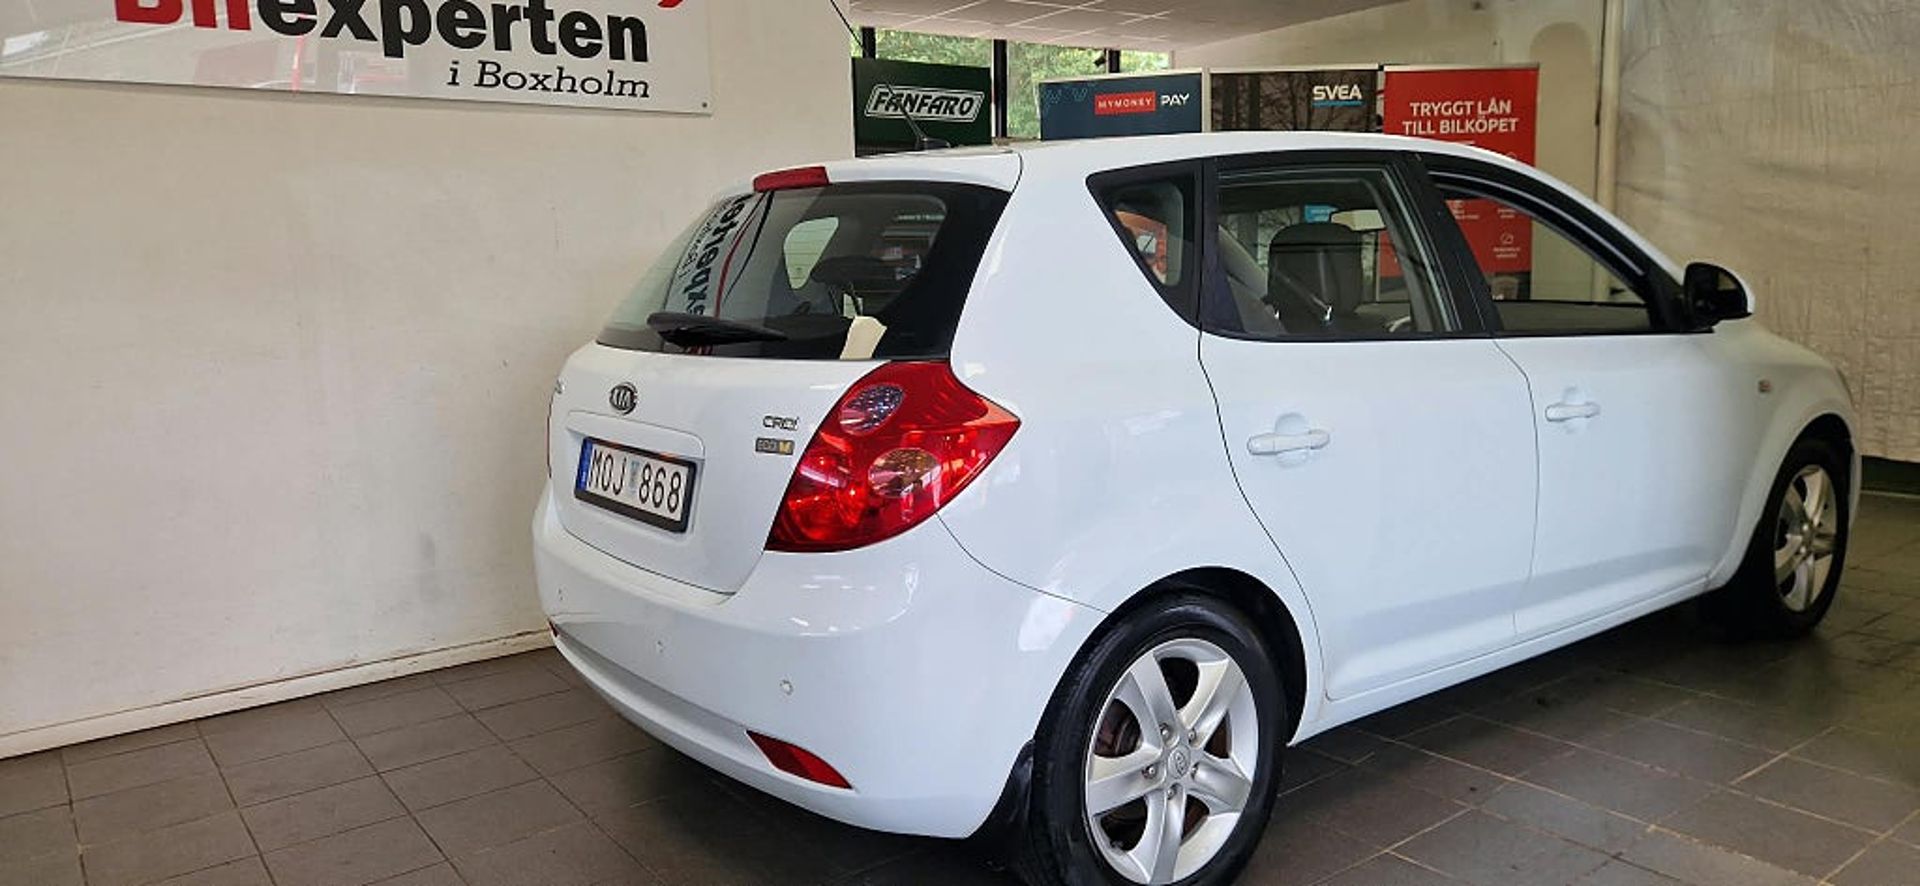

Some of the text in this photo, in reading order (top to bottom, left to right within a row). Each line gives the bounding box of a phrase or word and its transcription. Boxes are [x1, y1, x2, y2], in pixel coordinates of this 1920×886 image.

[446, 59, 650, 98] i Boxholm
[872, 90, 975, 116] FANFARO
[1097, 93, 1190, 109] MYMONEY PAY
[1312, 84, 1363, 101] SVEA
[1409, 97, 1512, 117] TRYGGT LÅN
[1402, 115, 1520, 136] TILL BILKÖPET
[588, 448, 682, 514] MOJ 868
